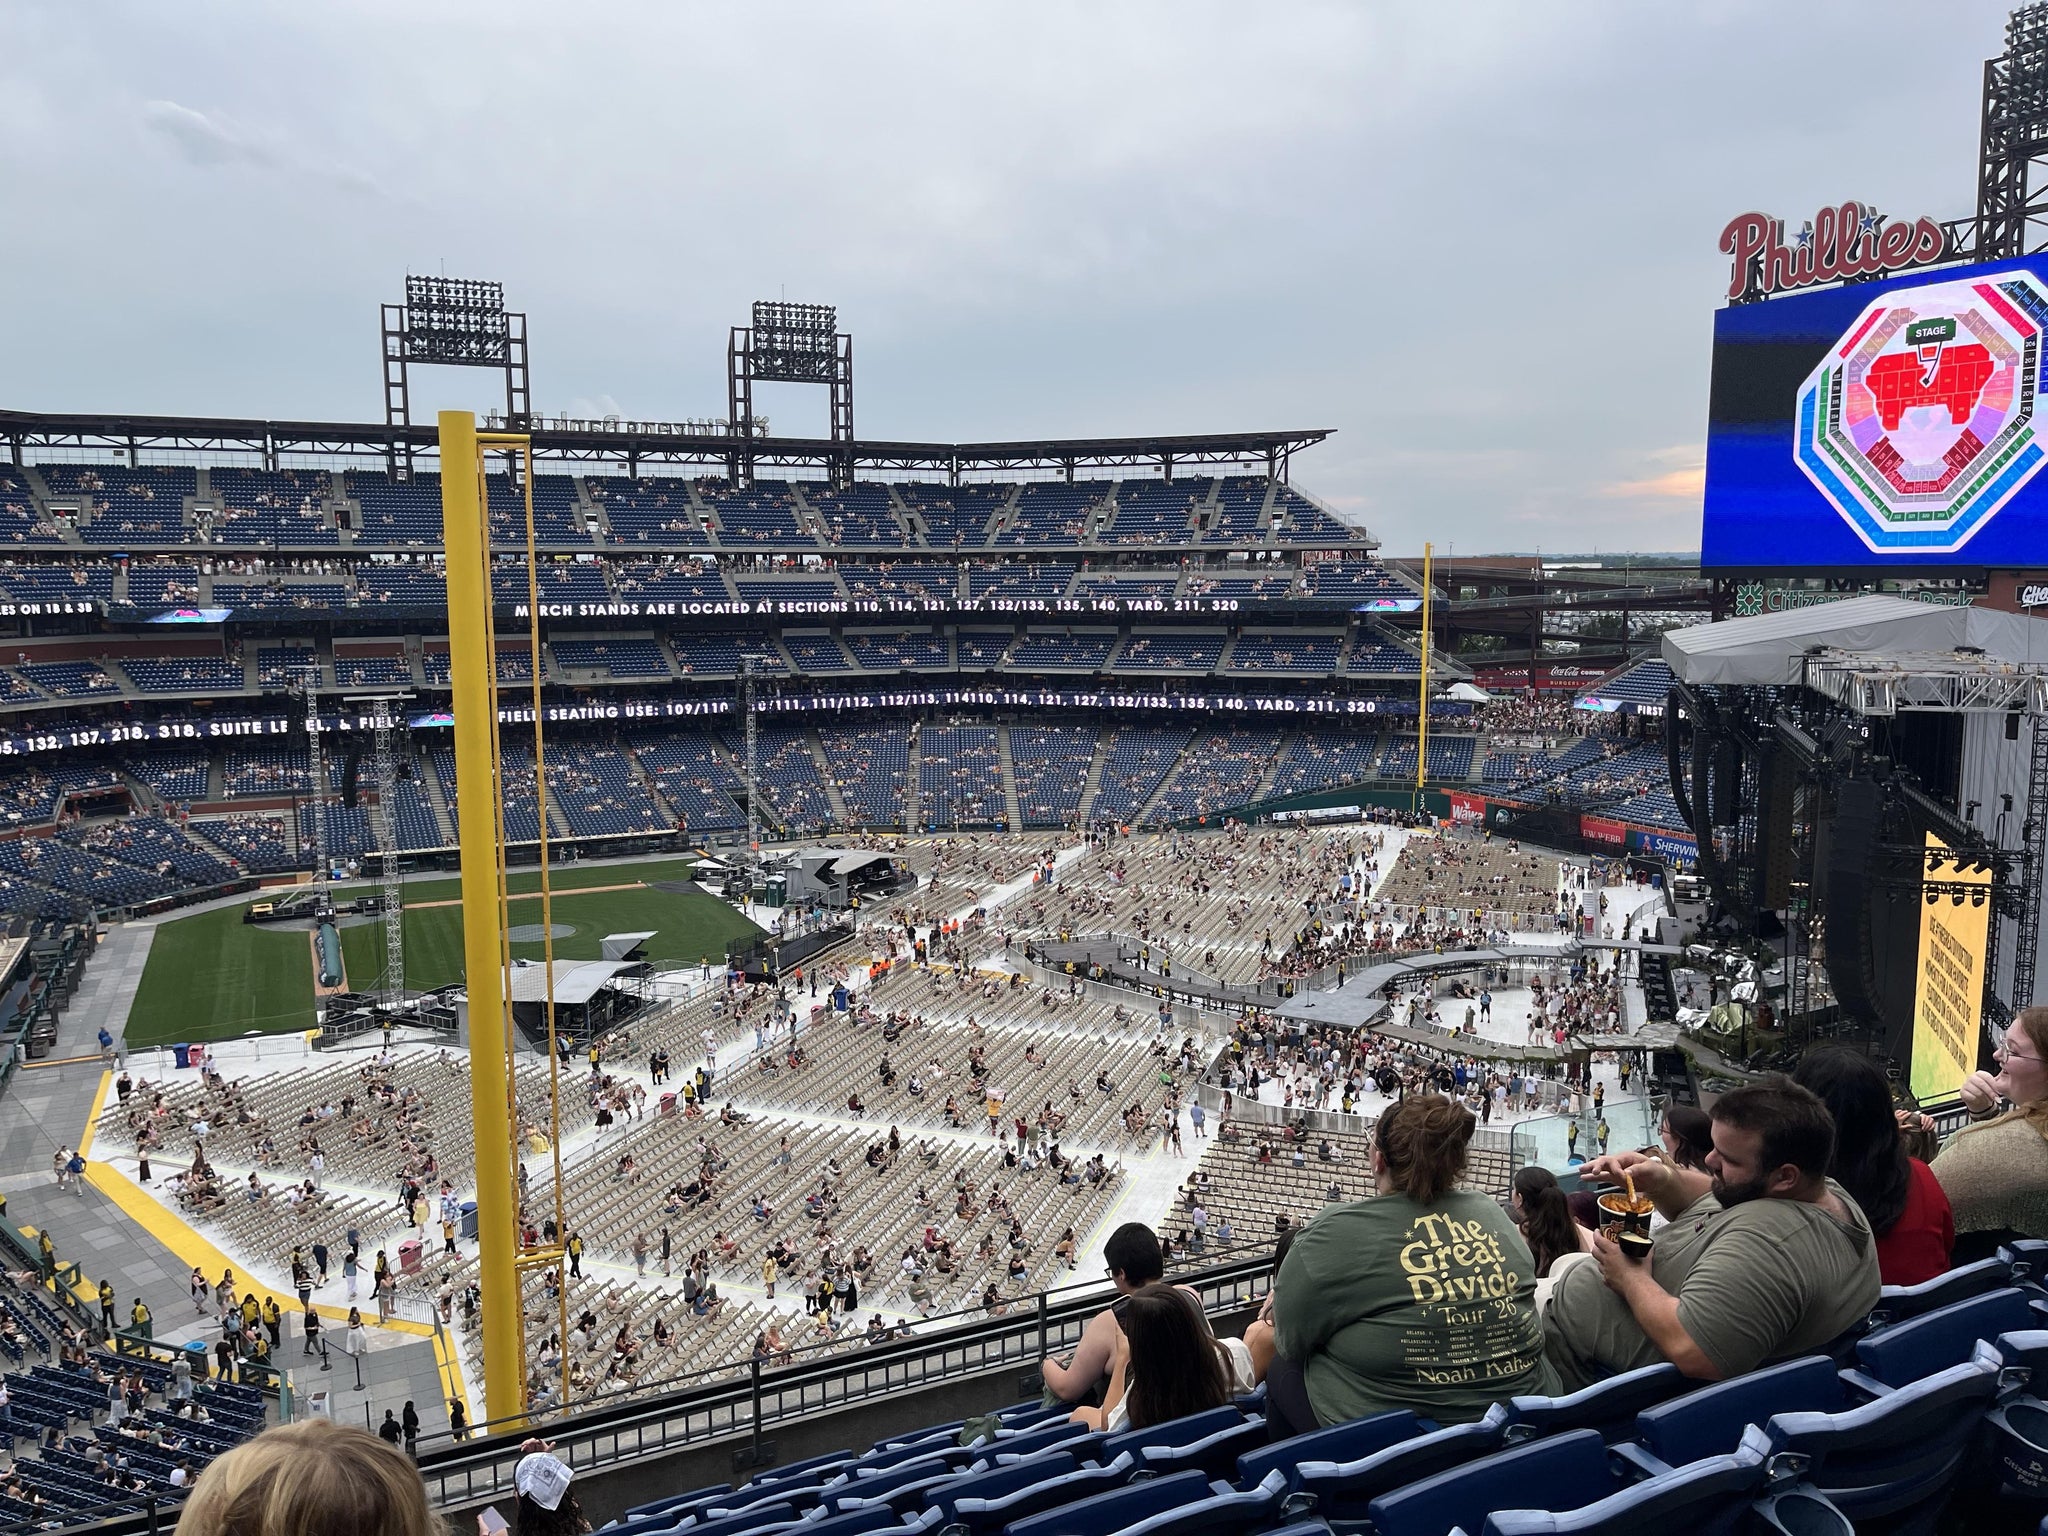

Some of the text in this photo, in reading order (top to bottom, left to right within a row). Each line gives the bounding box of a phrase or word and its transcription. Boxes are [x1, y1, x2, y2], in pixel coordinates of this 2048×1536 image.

[1719, 200, 1945, 299] Phillies
[1915, 325, 1947, 338] STAGE
[2025, 340, 2036, 348] 206
[21, 604, 41, 615] ON
[46, 603, 60, 614] 1B
[64, 603, 74, 614] &
[77, 602, 93, 614] 3B
[515, 600, 1239, 617] MRCH STANDS ARE LOCATED AT SECTIONS 110, 114, 121, 127, 132/133, 135, 140, YARD, 211, 320
[1919, 590, 1974, 607] Park
[549, 706, 619, 721] SEATING
[626, 705, 659, 717] USE:
[812, 696, 874, 710] 111/112,
[880, 693, 940, 707] 112/113,
[946, 692, 998, 705] 114110,
[1003, 693, 1033, 706] 114,
[1039, 694, 1068, 707] 121,
[1074, 694, 1103, 708] 127,
[1109, 696, 1173, 709] 132/133,
[1179, 697, 1211, 710] 135,
[1217, 698, 1249, 711] 140,
[1255, 699, 1301, 712] YARD,
[1306, 700, 1340, 713] 211,
[1347, 701, 1376, 713] 320
[1637, 704, 1664, 716] FIRST
[26, 735, 63, 752] 132,
[71, 731, 106, 747] 137,
[111, 726, 150, 742] 218,
[158, 724, 202, 739] 318,
[210, 721, 262, 736] SUITE
[271, 718, 332, 734] LEEL,
[339, 718, 352, 730] &
[359, 716, 401, 730] FIEL
[1452, 791, 1480, 800] ASPLUNDH
[1452, 804, 1484, 821] Wawa
[1585, 816, 1697, 843] ASPLUNDH ASPLUNDH ASPLUND
[1655, 838, 1700, 858] SHERWIN
[1414, 1212, 1488, 1247] The
[1400, 1235, 1507, 1275] Great
[1406, 1263, 1520, 1305] Divide
[1437, 1296, 1518, 1327] Tour '26
[1415, 1355, 1539, 1385] Noah Kahan
[2003, 1456, 2039, 1480] Citizens
[2017, 1474, 2038, 1488] Park
